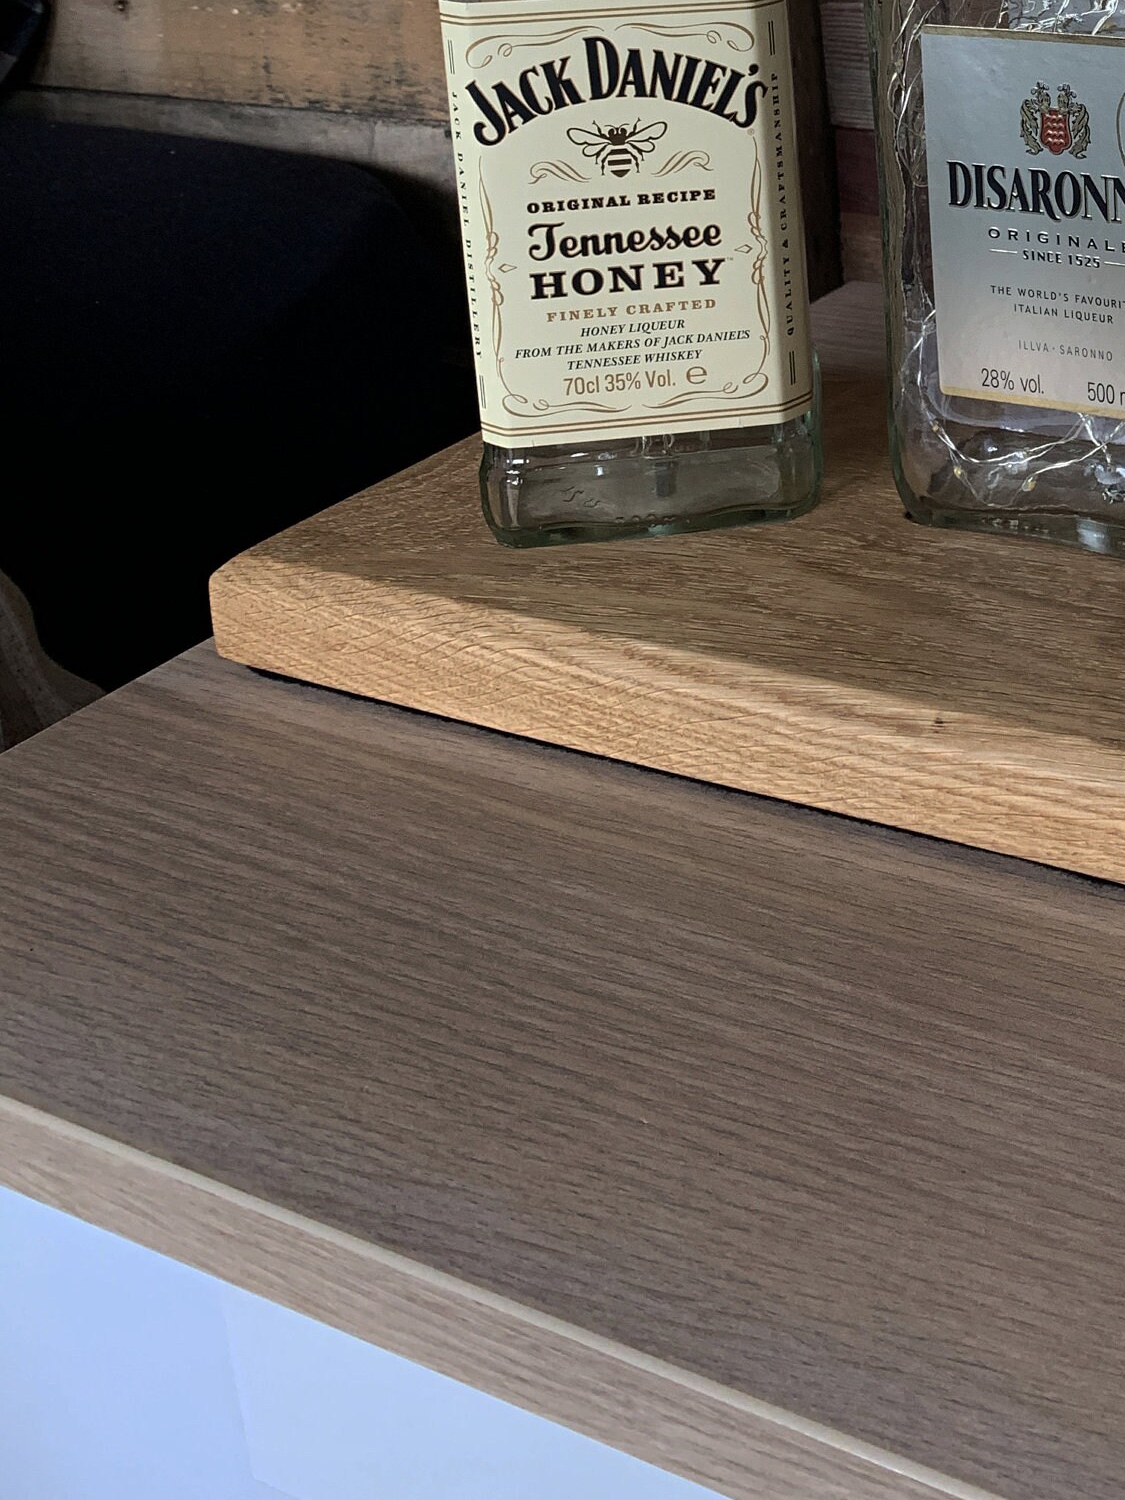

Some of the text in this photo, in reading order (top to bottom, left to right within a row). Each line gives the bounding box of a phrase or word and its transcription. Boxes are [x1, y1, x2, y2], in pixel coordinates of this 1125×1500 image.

[465, 36, 769, 146] JACK DANIEL'S
[770, 73, 788, 232] CRAFTSMANSHIP
[526, 189, 716, 214] ORIGINAL RECIPE
[451, 91, 482, 359] JACK DANIEL DISTILLERY
[527, 221, 722, 261] Tennessee
[1023, 250, 1101, 269] SINCE 1525
[529, 257, 726, 300] HONEY
[783, 257, 795, 337] QUALITY
[990, 285, 1012, 296] THE
[1017, 288, 1069, 302] WORLD'S
[547, 299, 717, 322] FINELY CRAFTED
[1014, 304, 1114, 324] ITALIAN LIQUEUR
[580, 319, 686, 337] HONEY LIQUEUR
[515, 329, 751, 359] FROM THE MAKERS OF JACK DANIEL'S
[1059, 345, 1113, 361] SARONNO
[567, 349, 703, 370] TENNESSEE WHISKEY
[563, 376, 600, 396] 70cl
[604, 372, 641, 392] 35%
[645, 369, 676, 389] Vol.
[981, 368, 1015, 390] 28%
[1019, 374, 1045, 394] vol.
[1087, 382, 1115, 404] 500
